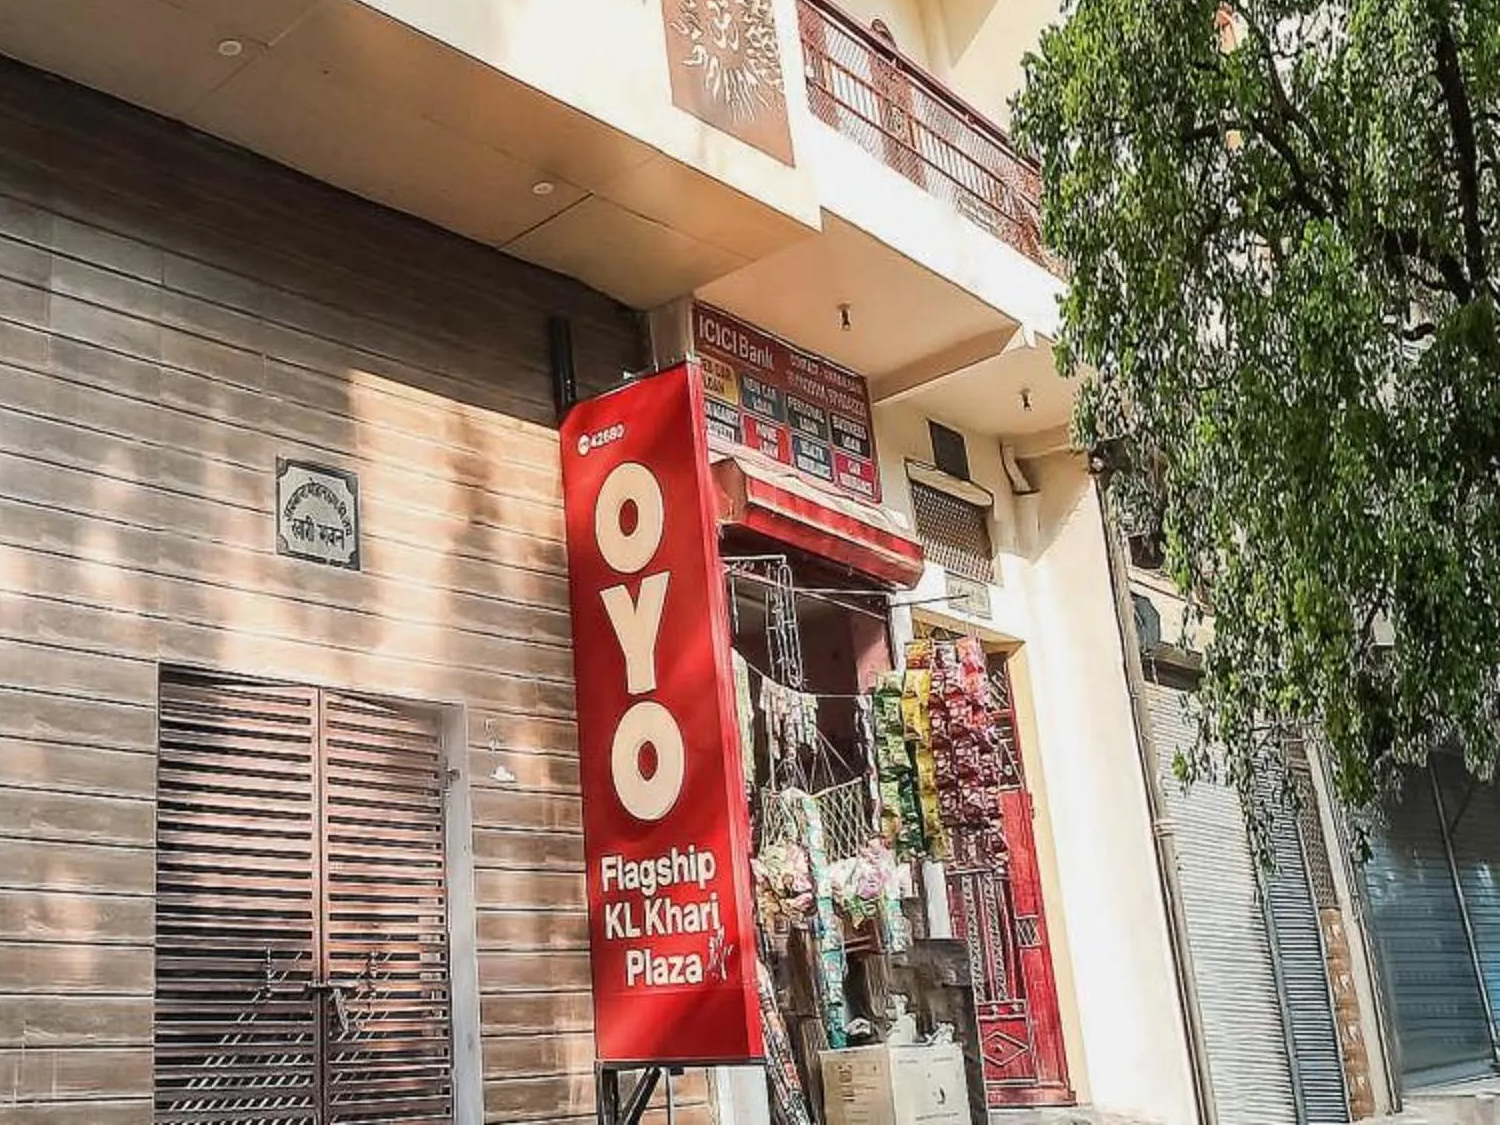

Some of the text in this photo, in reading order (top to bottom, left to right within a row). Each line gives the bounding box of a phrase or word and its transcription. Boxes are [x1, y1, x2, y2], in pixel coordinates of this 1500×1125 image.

[699, 314, 738, 355] ICICI
[739, 334, 774, 372] Bank
[595, 461, 685, 821] OYO
[601, 845, 717, 896] Flagship
[604, 891, 721, 940] KL Khari
[626, 948, 704, 988] Plaza
